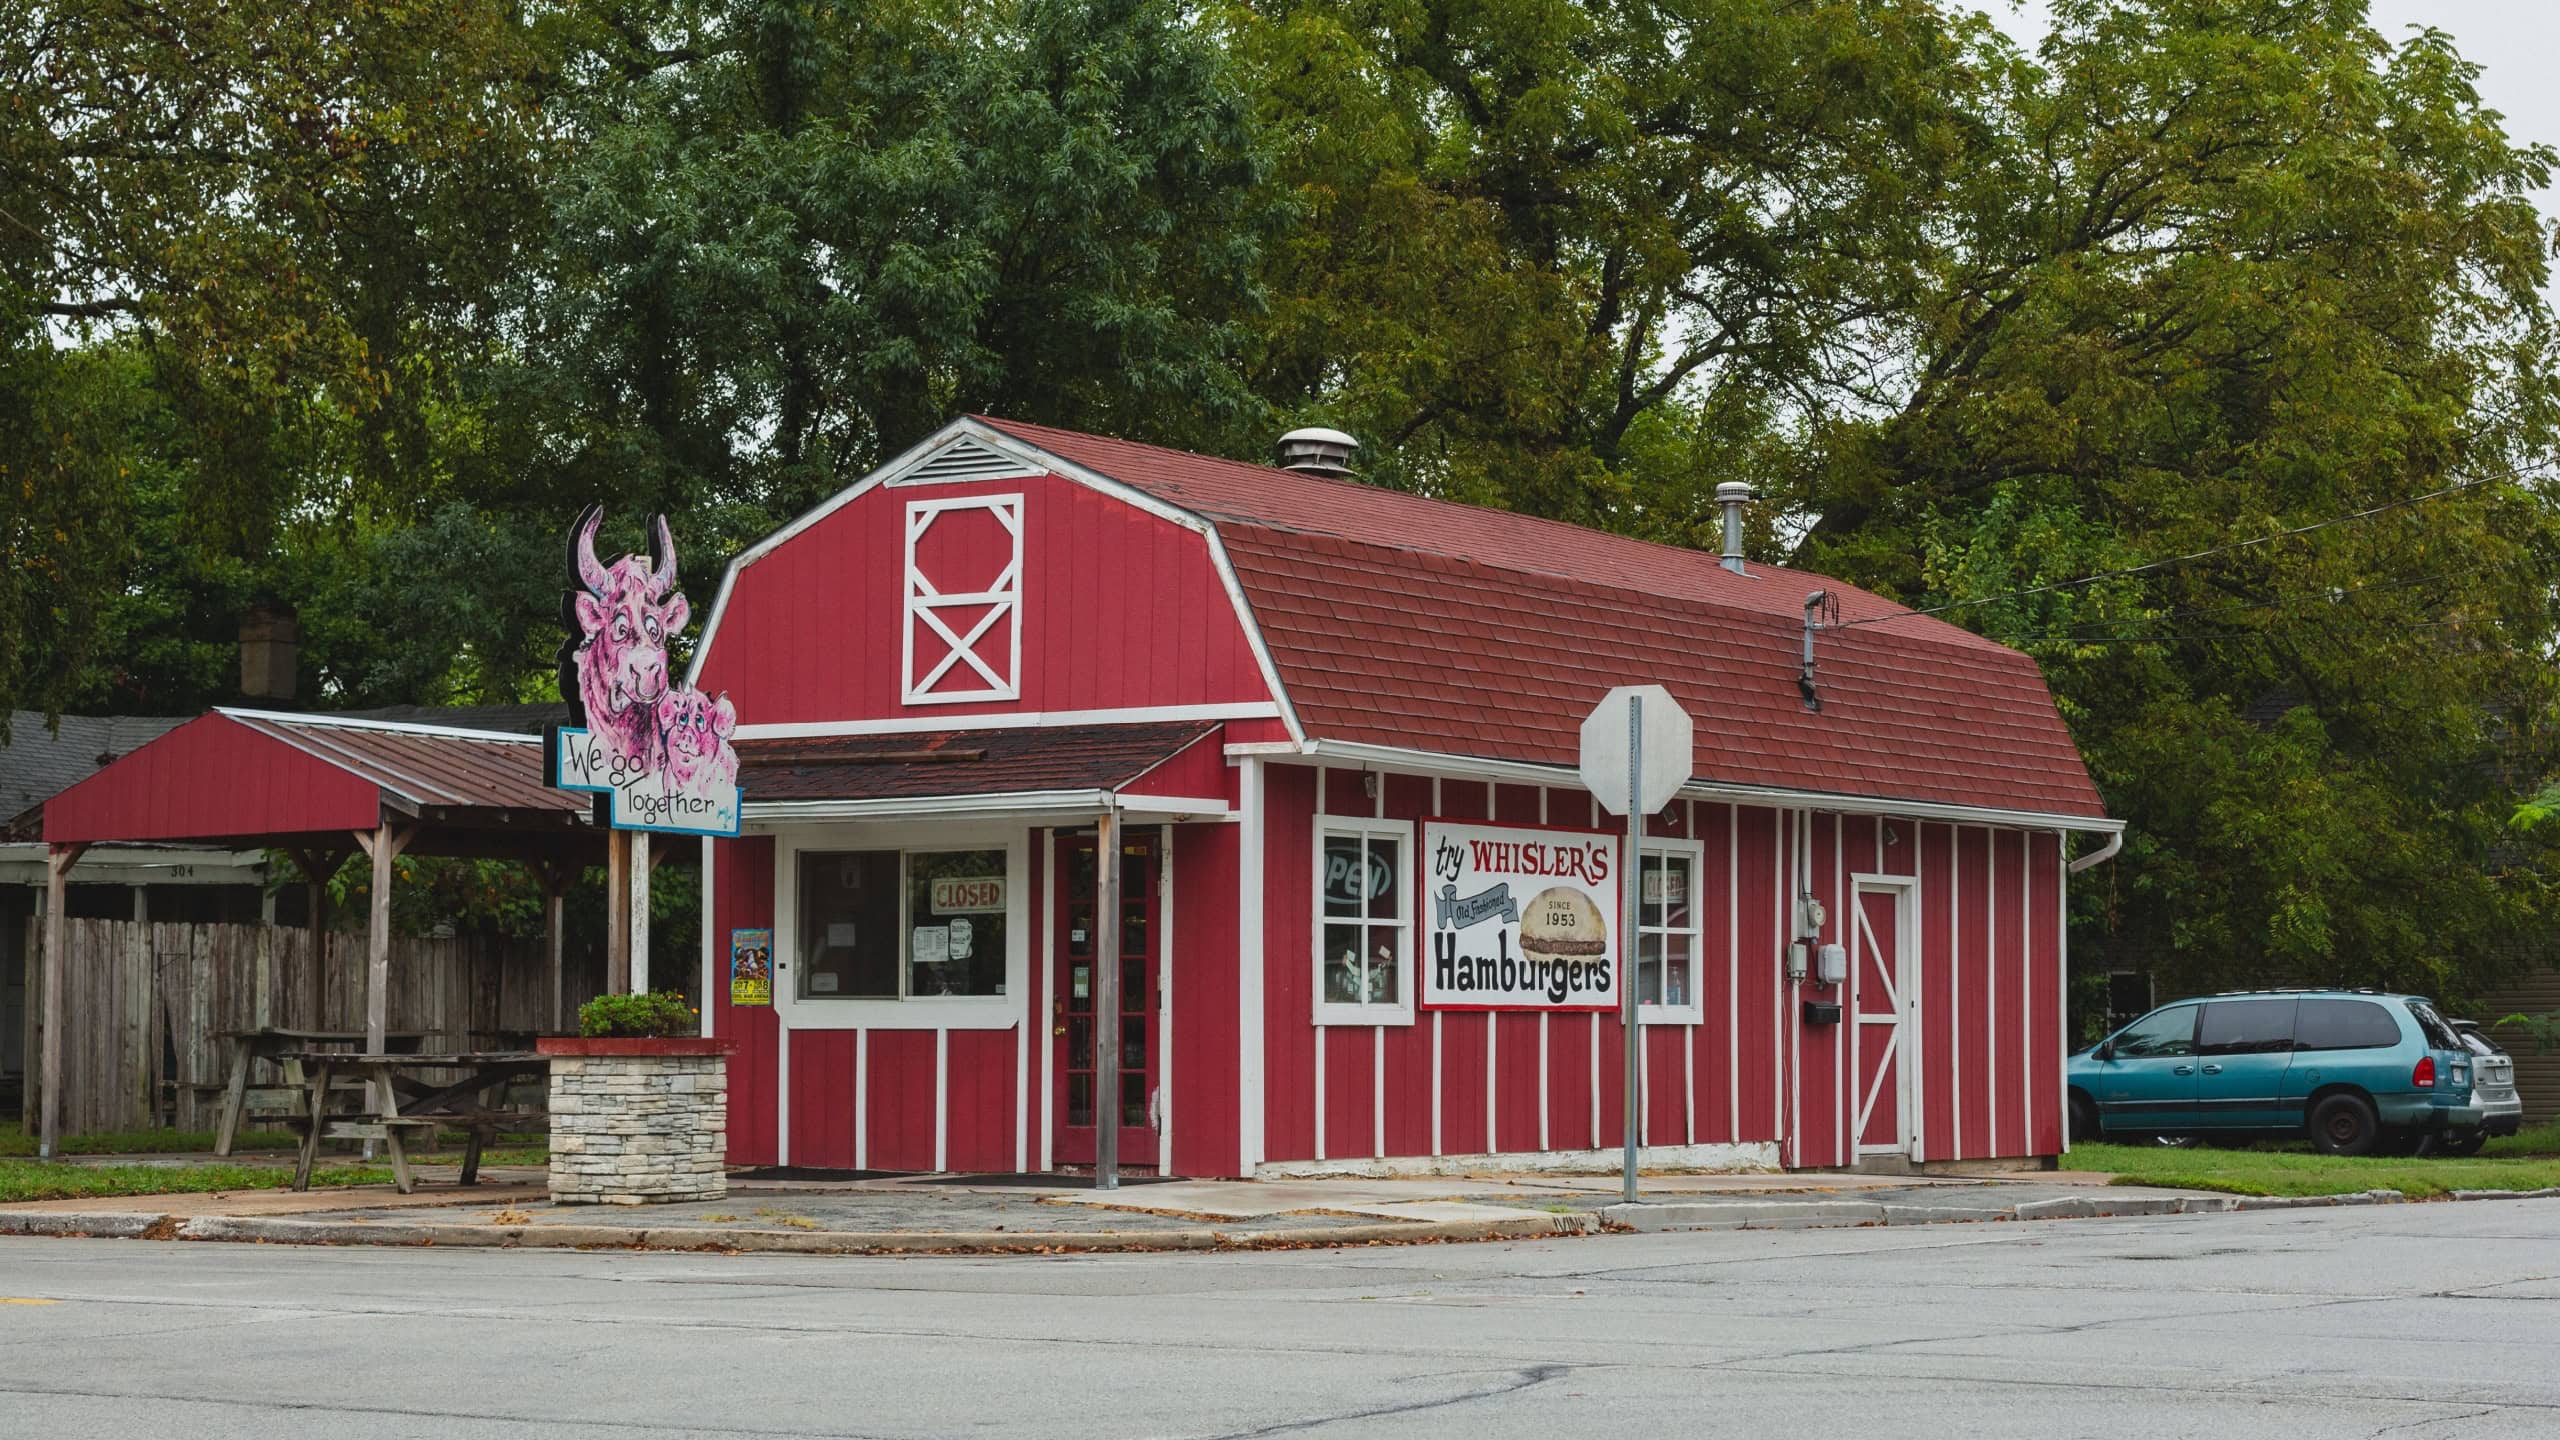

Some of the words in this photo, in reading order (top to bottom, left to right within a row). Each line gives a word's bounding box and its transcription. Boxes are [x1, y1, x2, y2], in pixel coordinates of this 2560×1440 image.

[566, 734, 604, 784] We
[609, 753, 644, 787] go
[622, 772, 716, 825] Together
[171, 865, 193, 877] 304
[1325, 854, 1383, 899] PEN
[1435, 835, 1464, 882] try
[1469, 840, 1609, 886] WHISLER'S
[936, 883, 1000, 908] CLOSED
[1457, 905, 1470, 920] Old
[1548, 901, 1571, 910] SINCE
[1546, 914, 1576, 927] 1953
[1434, 929, 1611, 1004] Hamburgers
